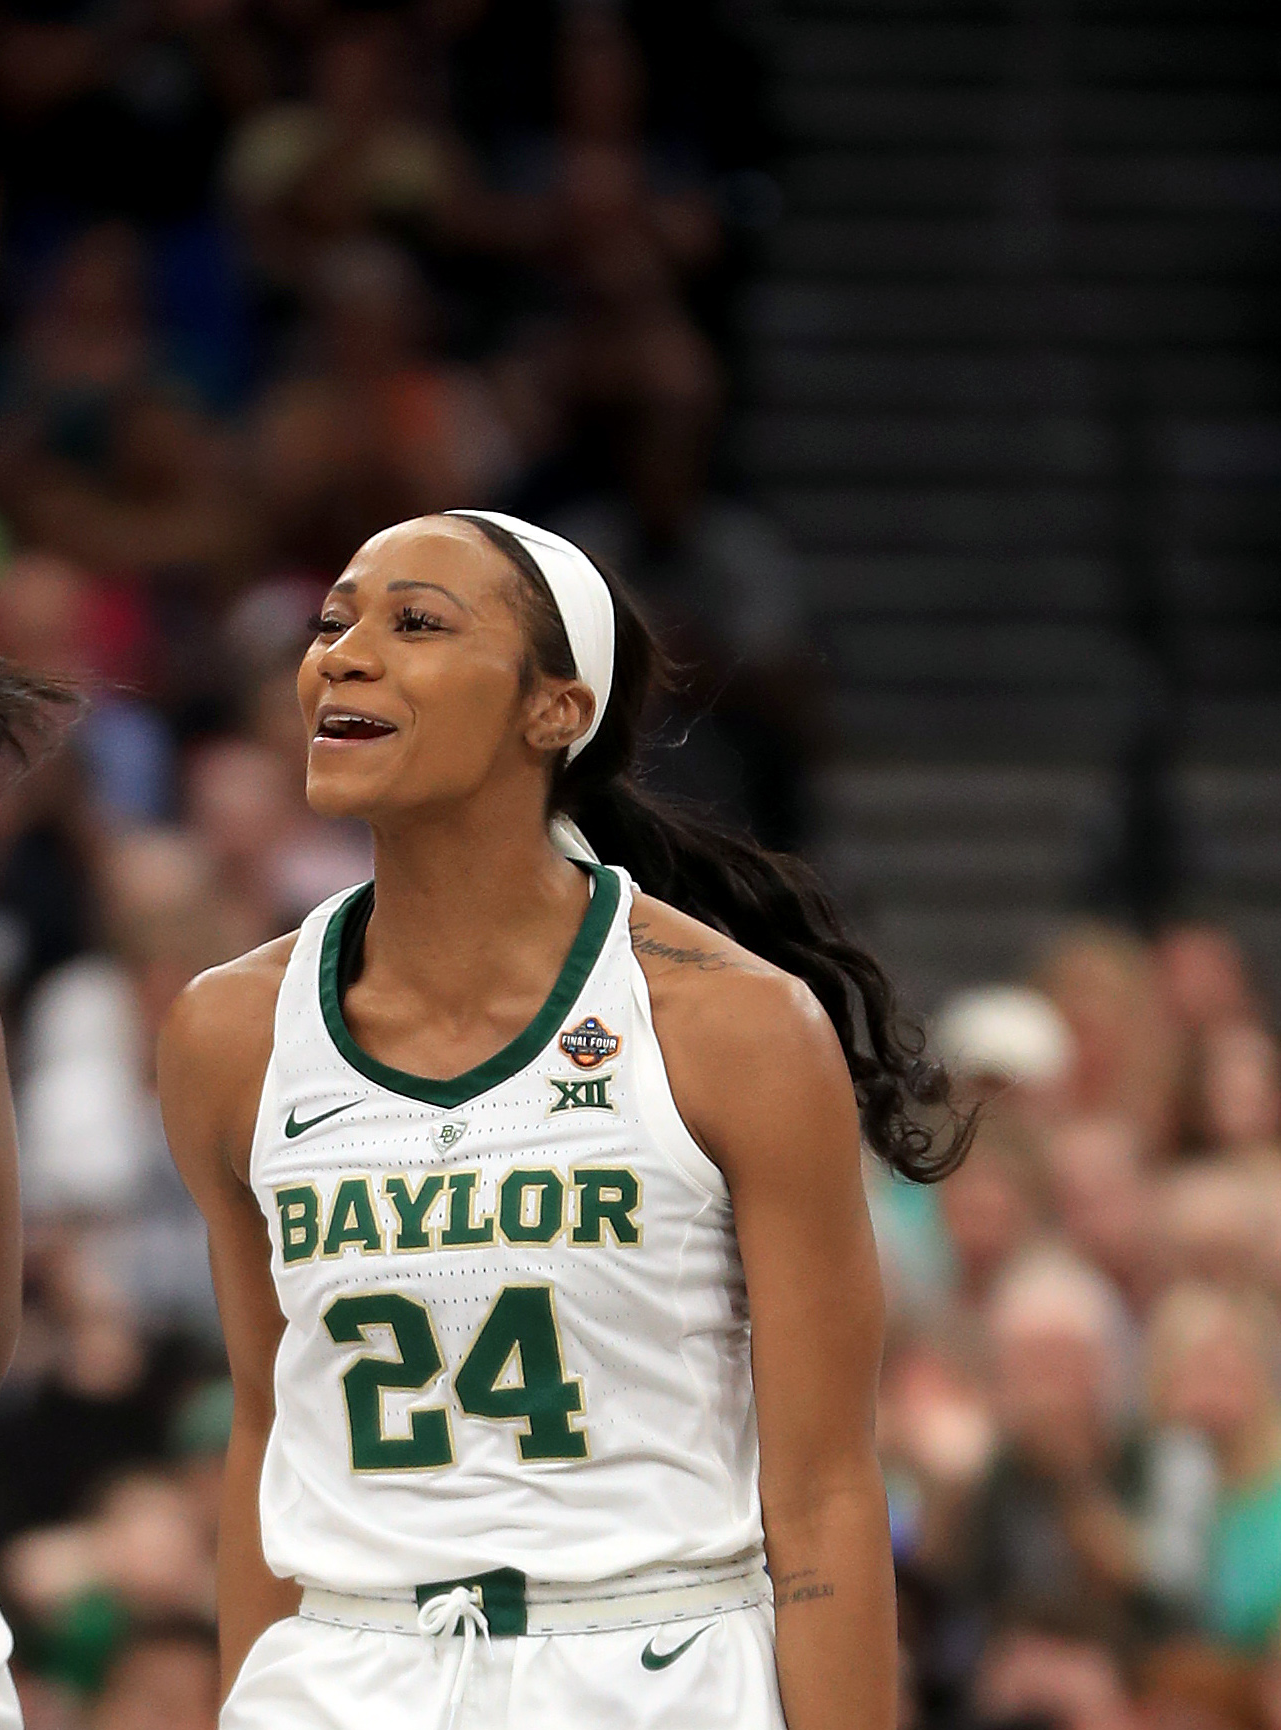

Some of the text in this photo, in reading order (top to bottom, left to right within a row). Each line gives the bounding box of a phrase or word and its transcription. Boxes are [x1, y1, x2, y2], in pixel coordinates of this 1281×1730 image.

[561, 1034, 617, 1050] FINAL FOUR
[548, 1074, 616, 1114] XII
[273, 1164, 644, 1268] BAYLOR
[319, 1281, 592, 1472] 24
